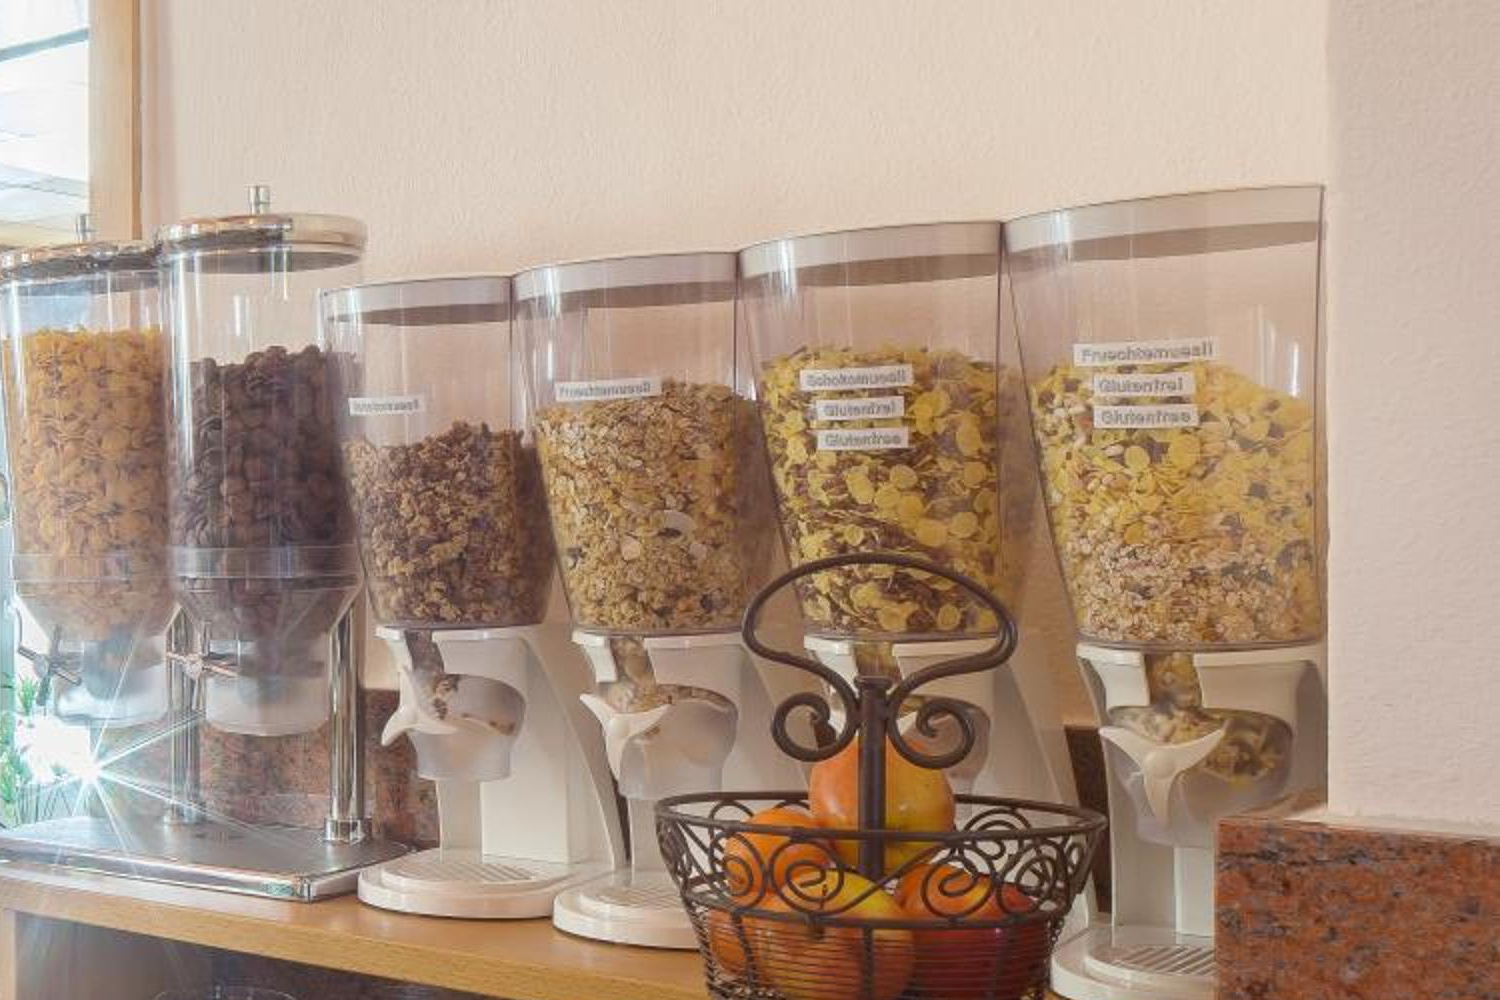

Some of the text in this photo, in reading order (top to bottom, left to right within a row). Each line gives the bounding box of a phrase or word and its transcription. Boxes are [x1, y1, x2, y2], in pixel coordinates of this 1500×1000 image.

[1099, 376, 1183, 393] Glutenfrei
[1100, 409, 1192, 425] Glutenfree
[824, 431, 901, 447] Glutenfree
